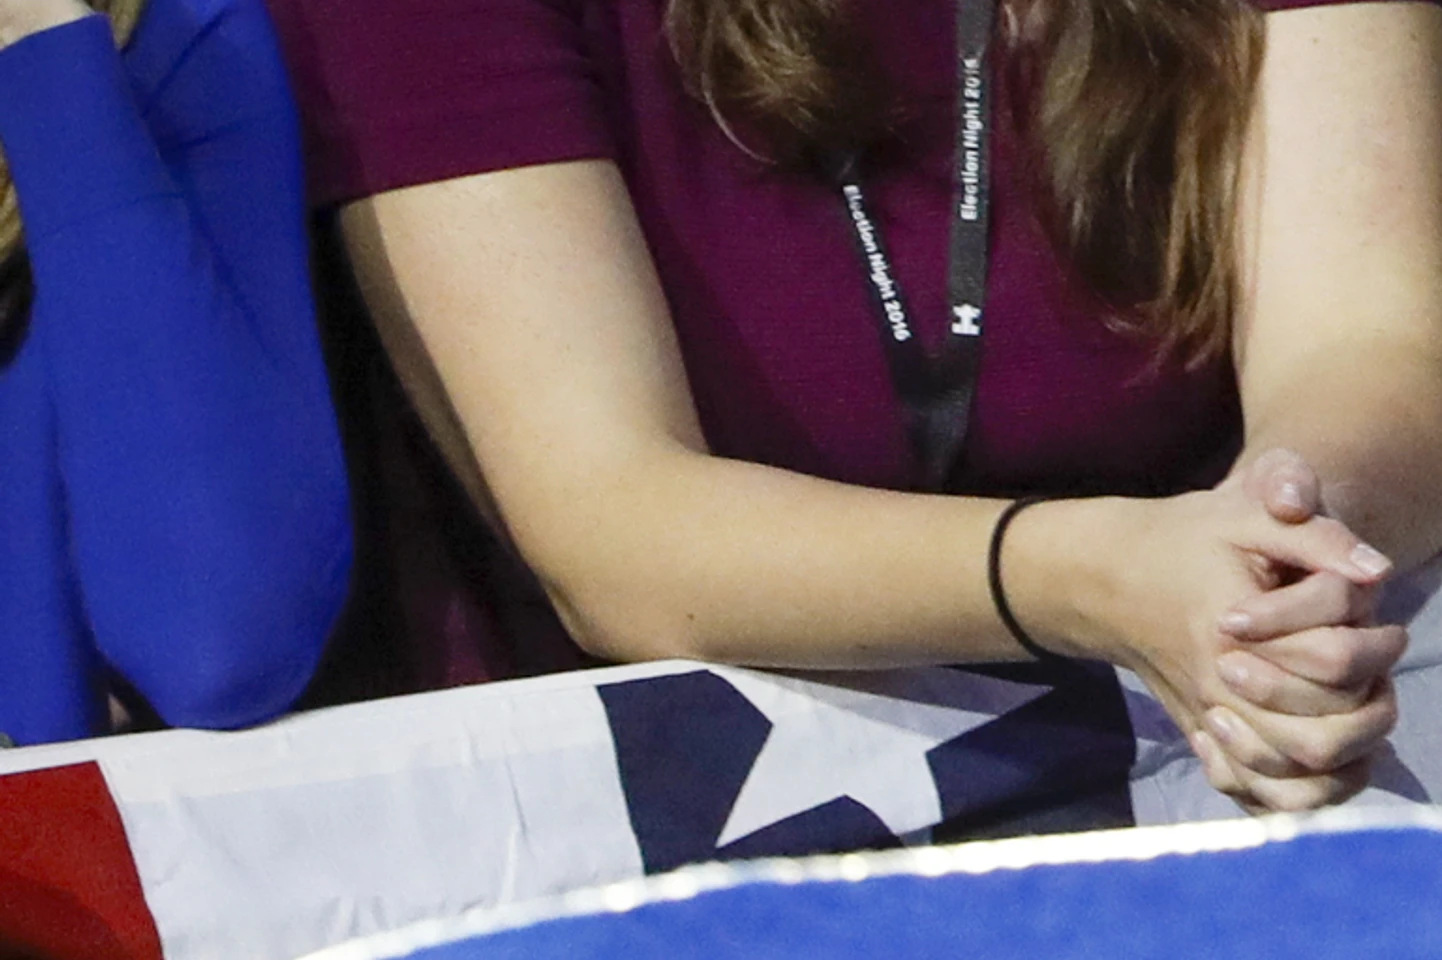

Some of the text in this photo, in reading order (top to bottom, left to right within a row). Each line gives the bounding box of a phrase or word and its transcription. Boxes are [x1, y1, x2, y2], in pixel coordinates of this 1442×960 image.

[962, 102, 983, 148] Night
[960, 151, 979, 220] Election
[843, 185, 912, 341] Election Night 2016
